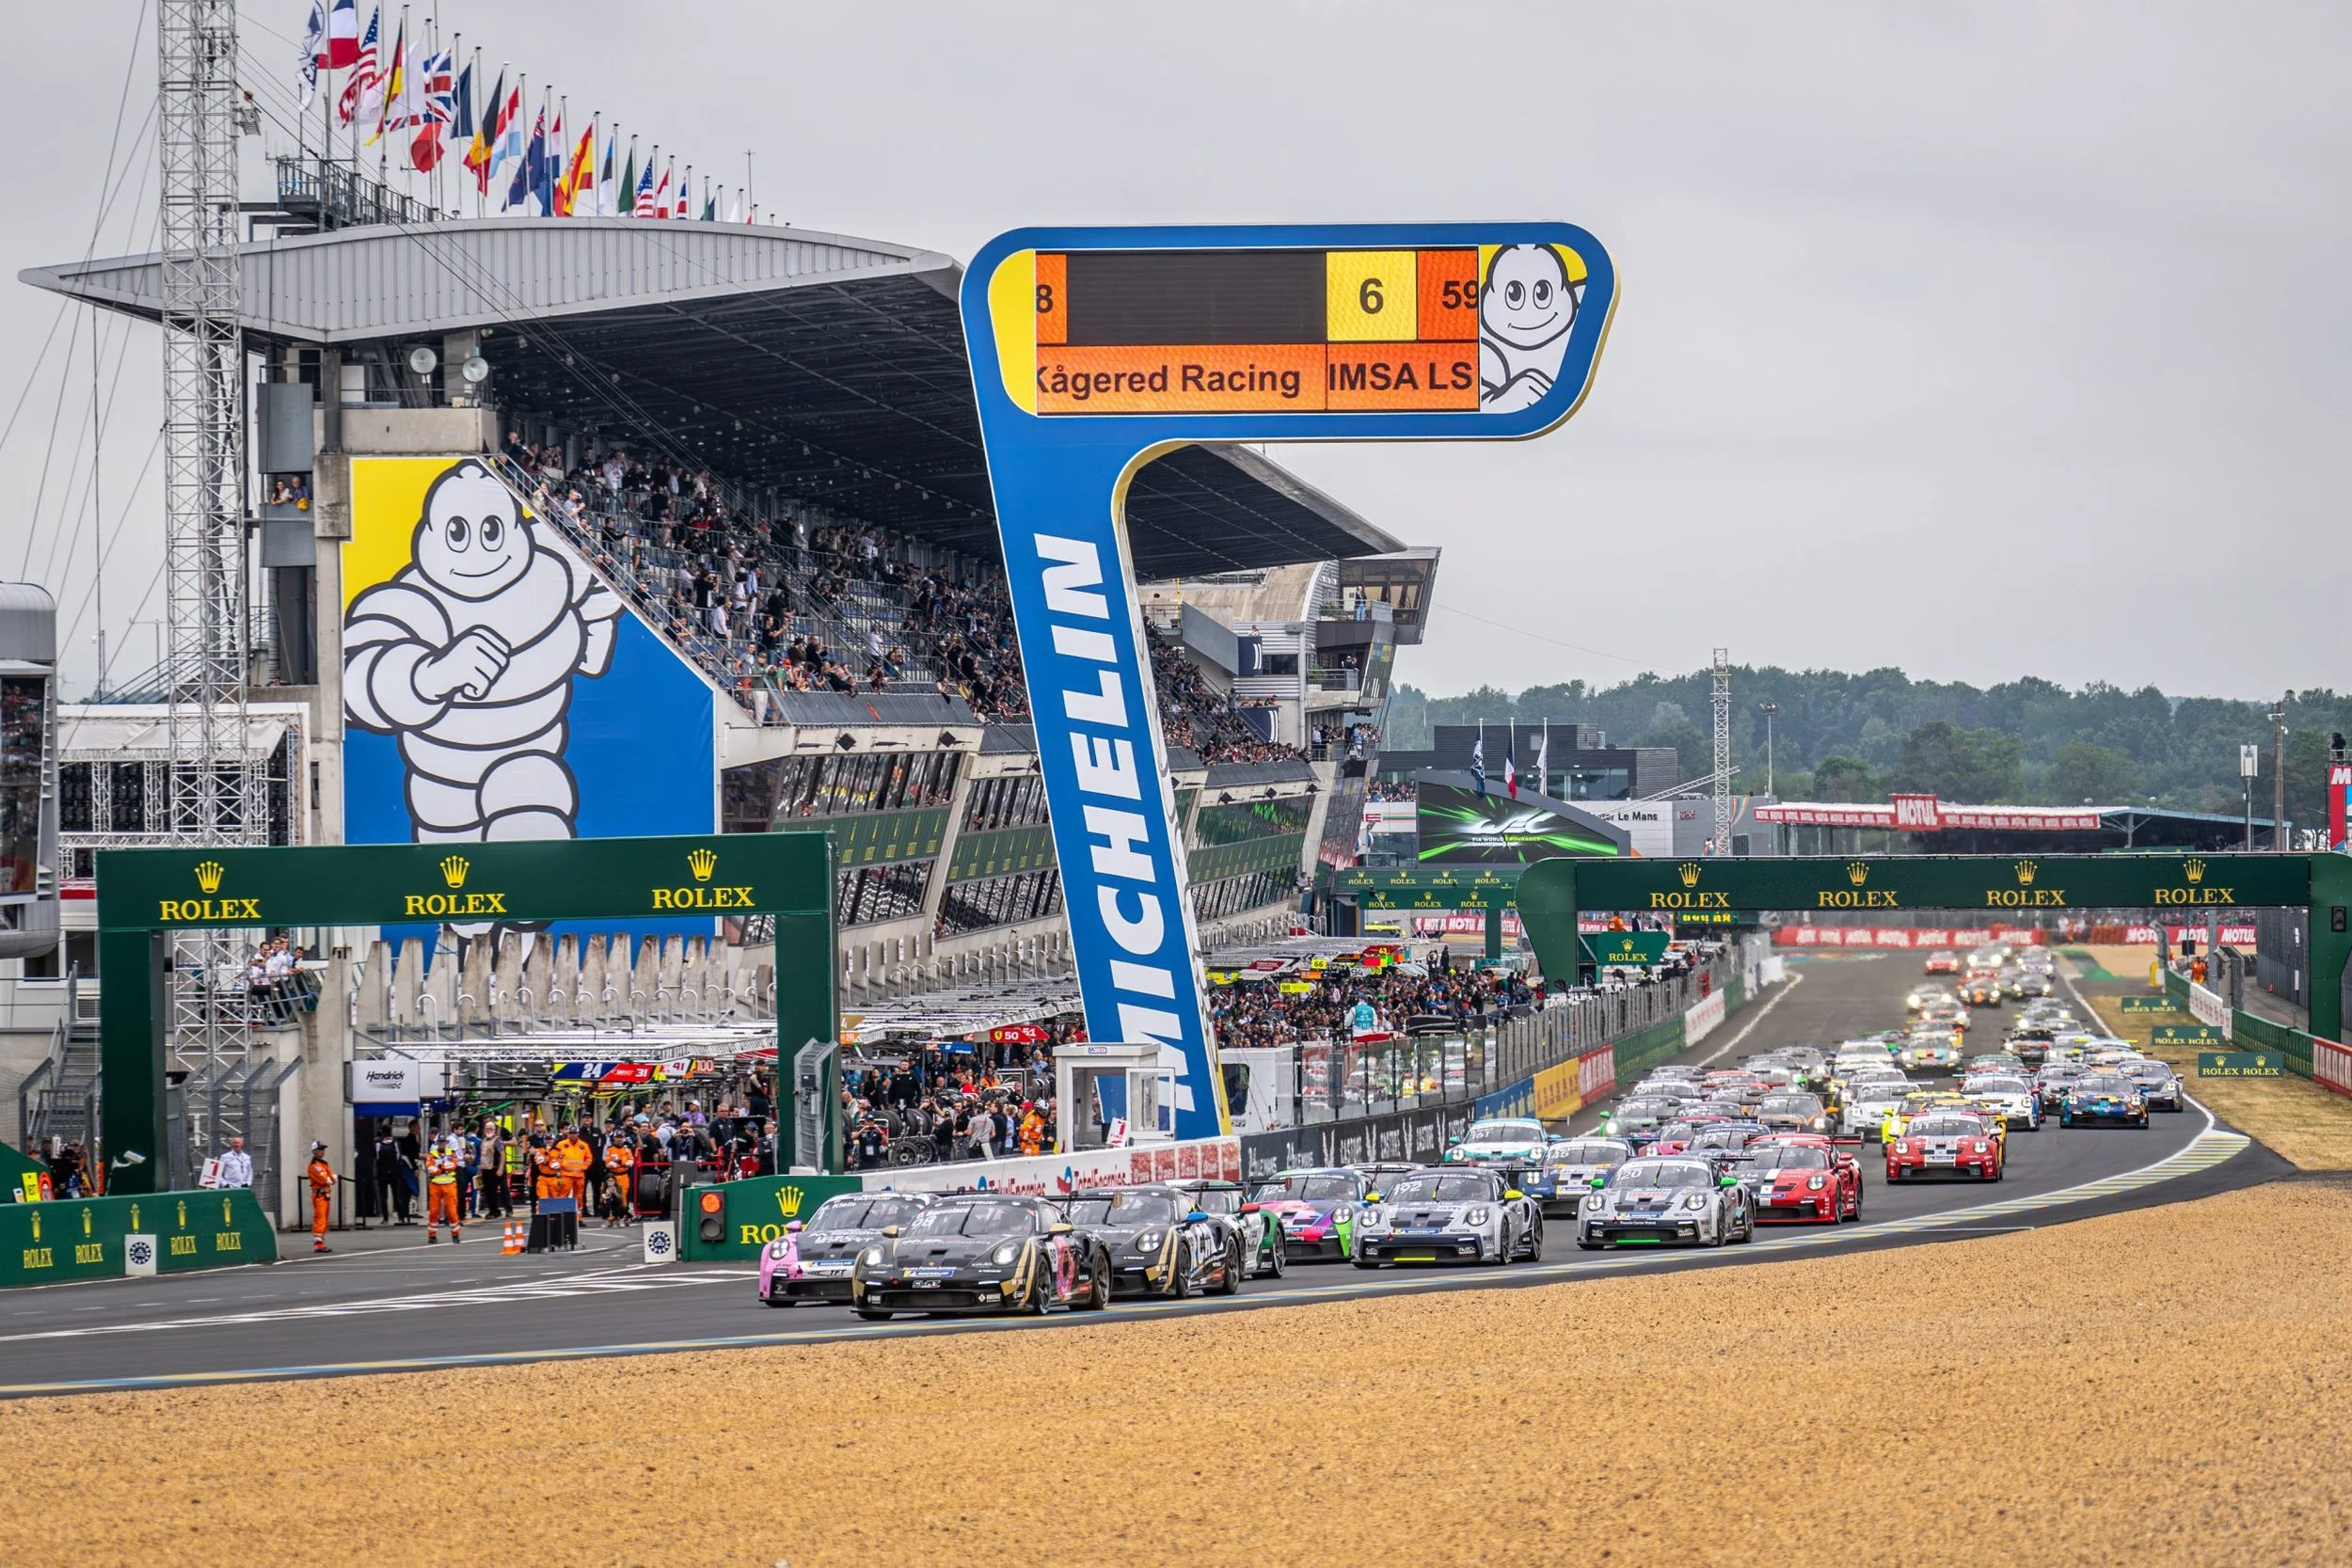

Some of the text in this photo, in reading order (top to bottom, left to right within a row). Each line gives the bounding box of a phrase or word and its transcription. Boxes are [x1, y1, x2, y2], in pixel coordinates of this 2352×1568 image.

[1359, 277, 1384, 315] 6
[1441, 281, 1478, 310] 59
[1182, 364, 1301, 400] Racing
[1328, 362, 1472, 391] IMSA LS
[1033, 532, 1197, 1111] MICHELIN
[1618, 812, 1629, 821] Le
[1632, 811, 1658, 821] Mans
[1897, 800, 1938, 826] MOTUL
[405, 894, 507, 915] ROLEX
[652, 887, 755, 909] ROLEX
[1650, 893, 1730, 908] ROLEX
[1819, 891, 1898, 908] ROLEX
[1986, 889, 2065, 906] ROLEX
[2154, 888, 2234, 905] ROLEX
[159, 899, 262, 921] ROLEX
[2177, 928, 2209, 943] MOTU
[2221, 928, 2255, 943] MOTUL
[1609, 953, 1647, 961] ROLEX
[1005, 1032, 1019, 1041] 50
[1023, 1028, 1036, 1037] 51
[581, 1063, 602, 1079] 24
[635, 1069, 648, 1077] 31
[674, 1062, 685, 1070] 91
[695, 1060, 714, 1072] 100
[2202, 1068, 2279, 1076] ROLEX ROLEX
[366, 1070, 405, 1081] Hendrick
[1615, 1167, 1642, 1181] 120
[1392, 1180, 1422, 1196] 192
[171, 1236, 196, 1255] ROLEX
[216, 1232, 242, 1251] ROLEX
[24, 1248, 53, 1268] ROLEX
[75, 1243, 103, 1263] ROLEX
